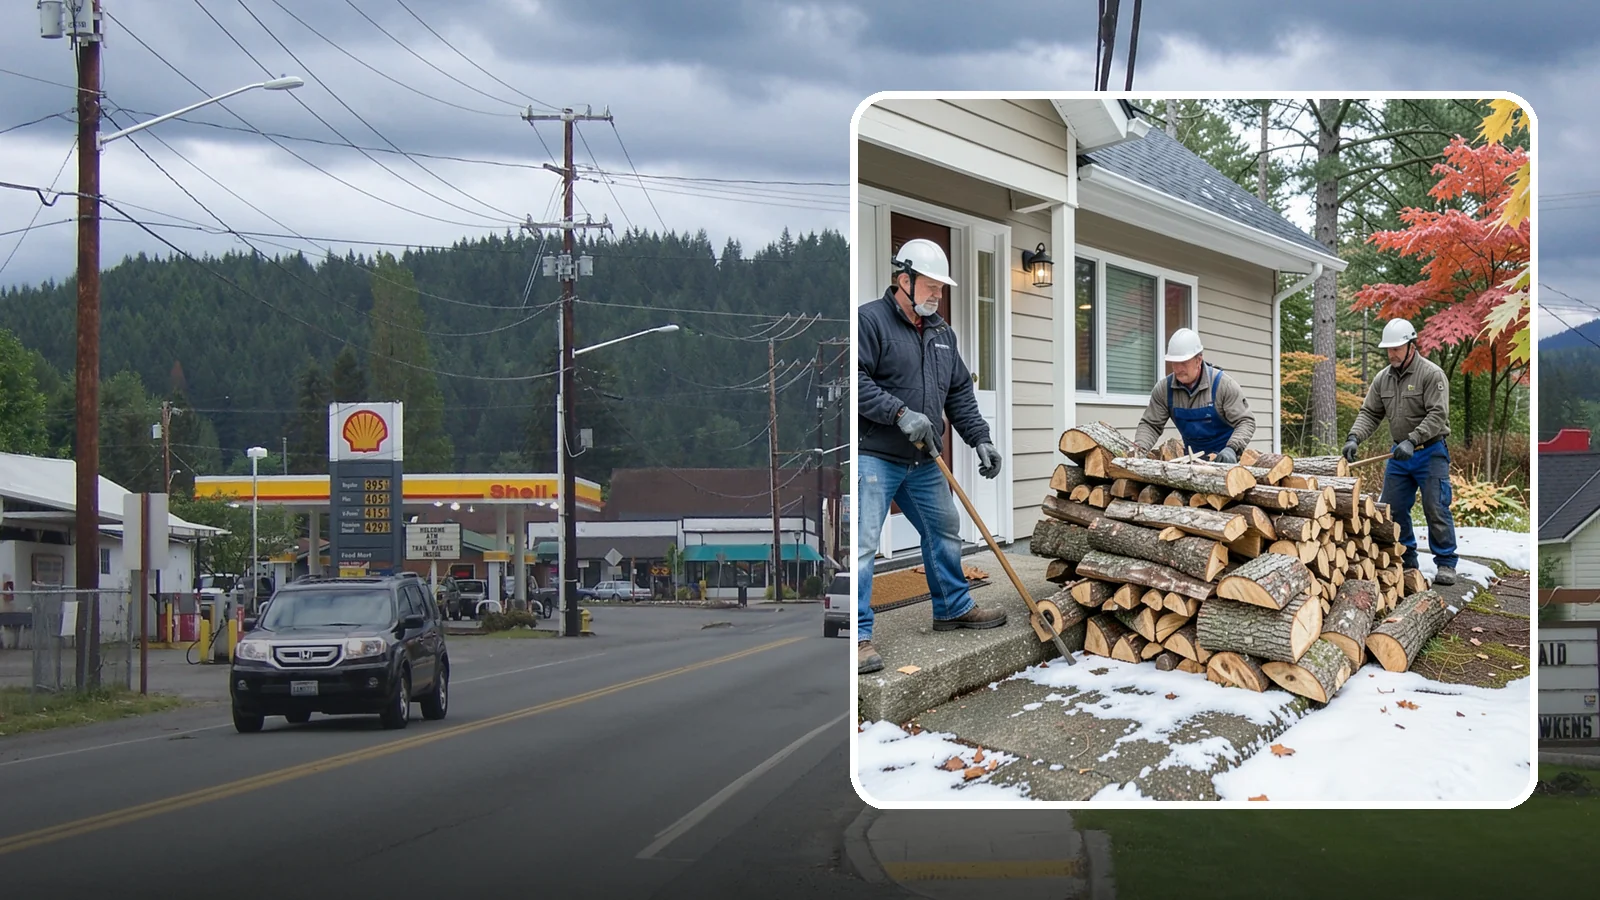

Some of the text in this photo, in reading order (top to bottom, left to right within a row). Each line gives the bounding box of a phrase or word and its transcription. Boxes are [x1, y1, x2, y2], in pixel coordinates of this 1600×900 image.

[366, 480, 383, 490] 395
[490, 484, 547, 499] Shell
[366, 494, 383, 504] 405
[366, 508, 383, 518] 415
[366, 522, 383, 533] 429
[1538, 643, 1567, 665] AID
